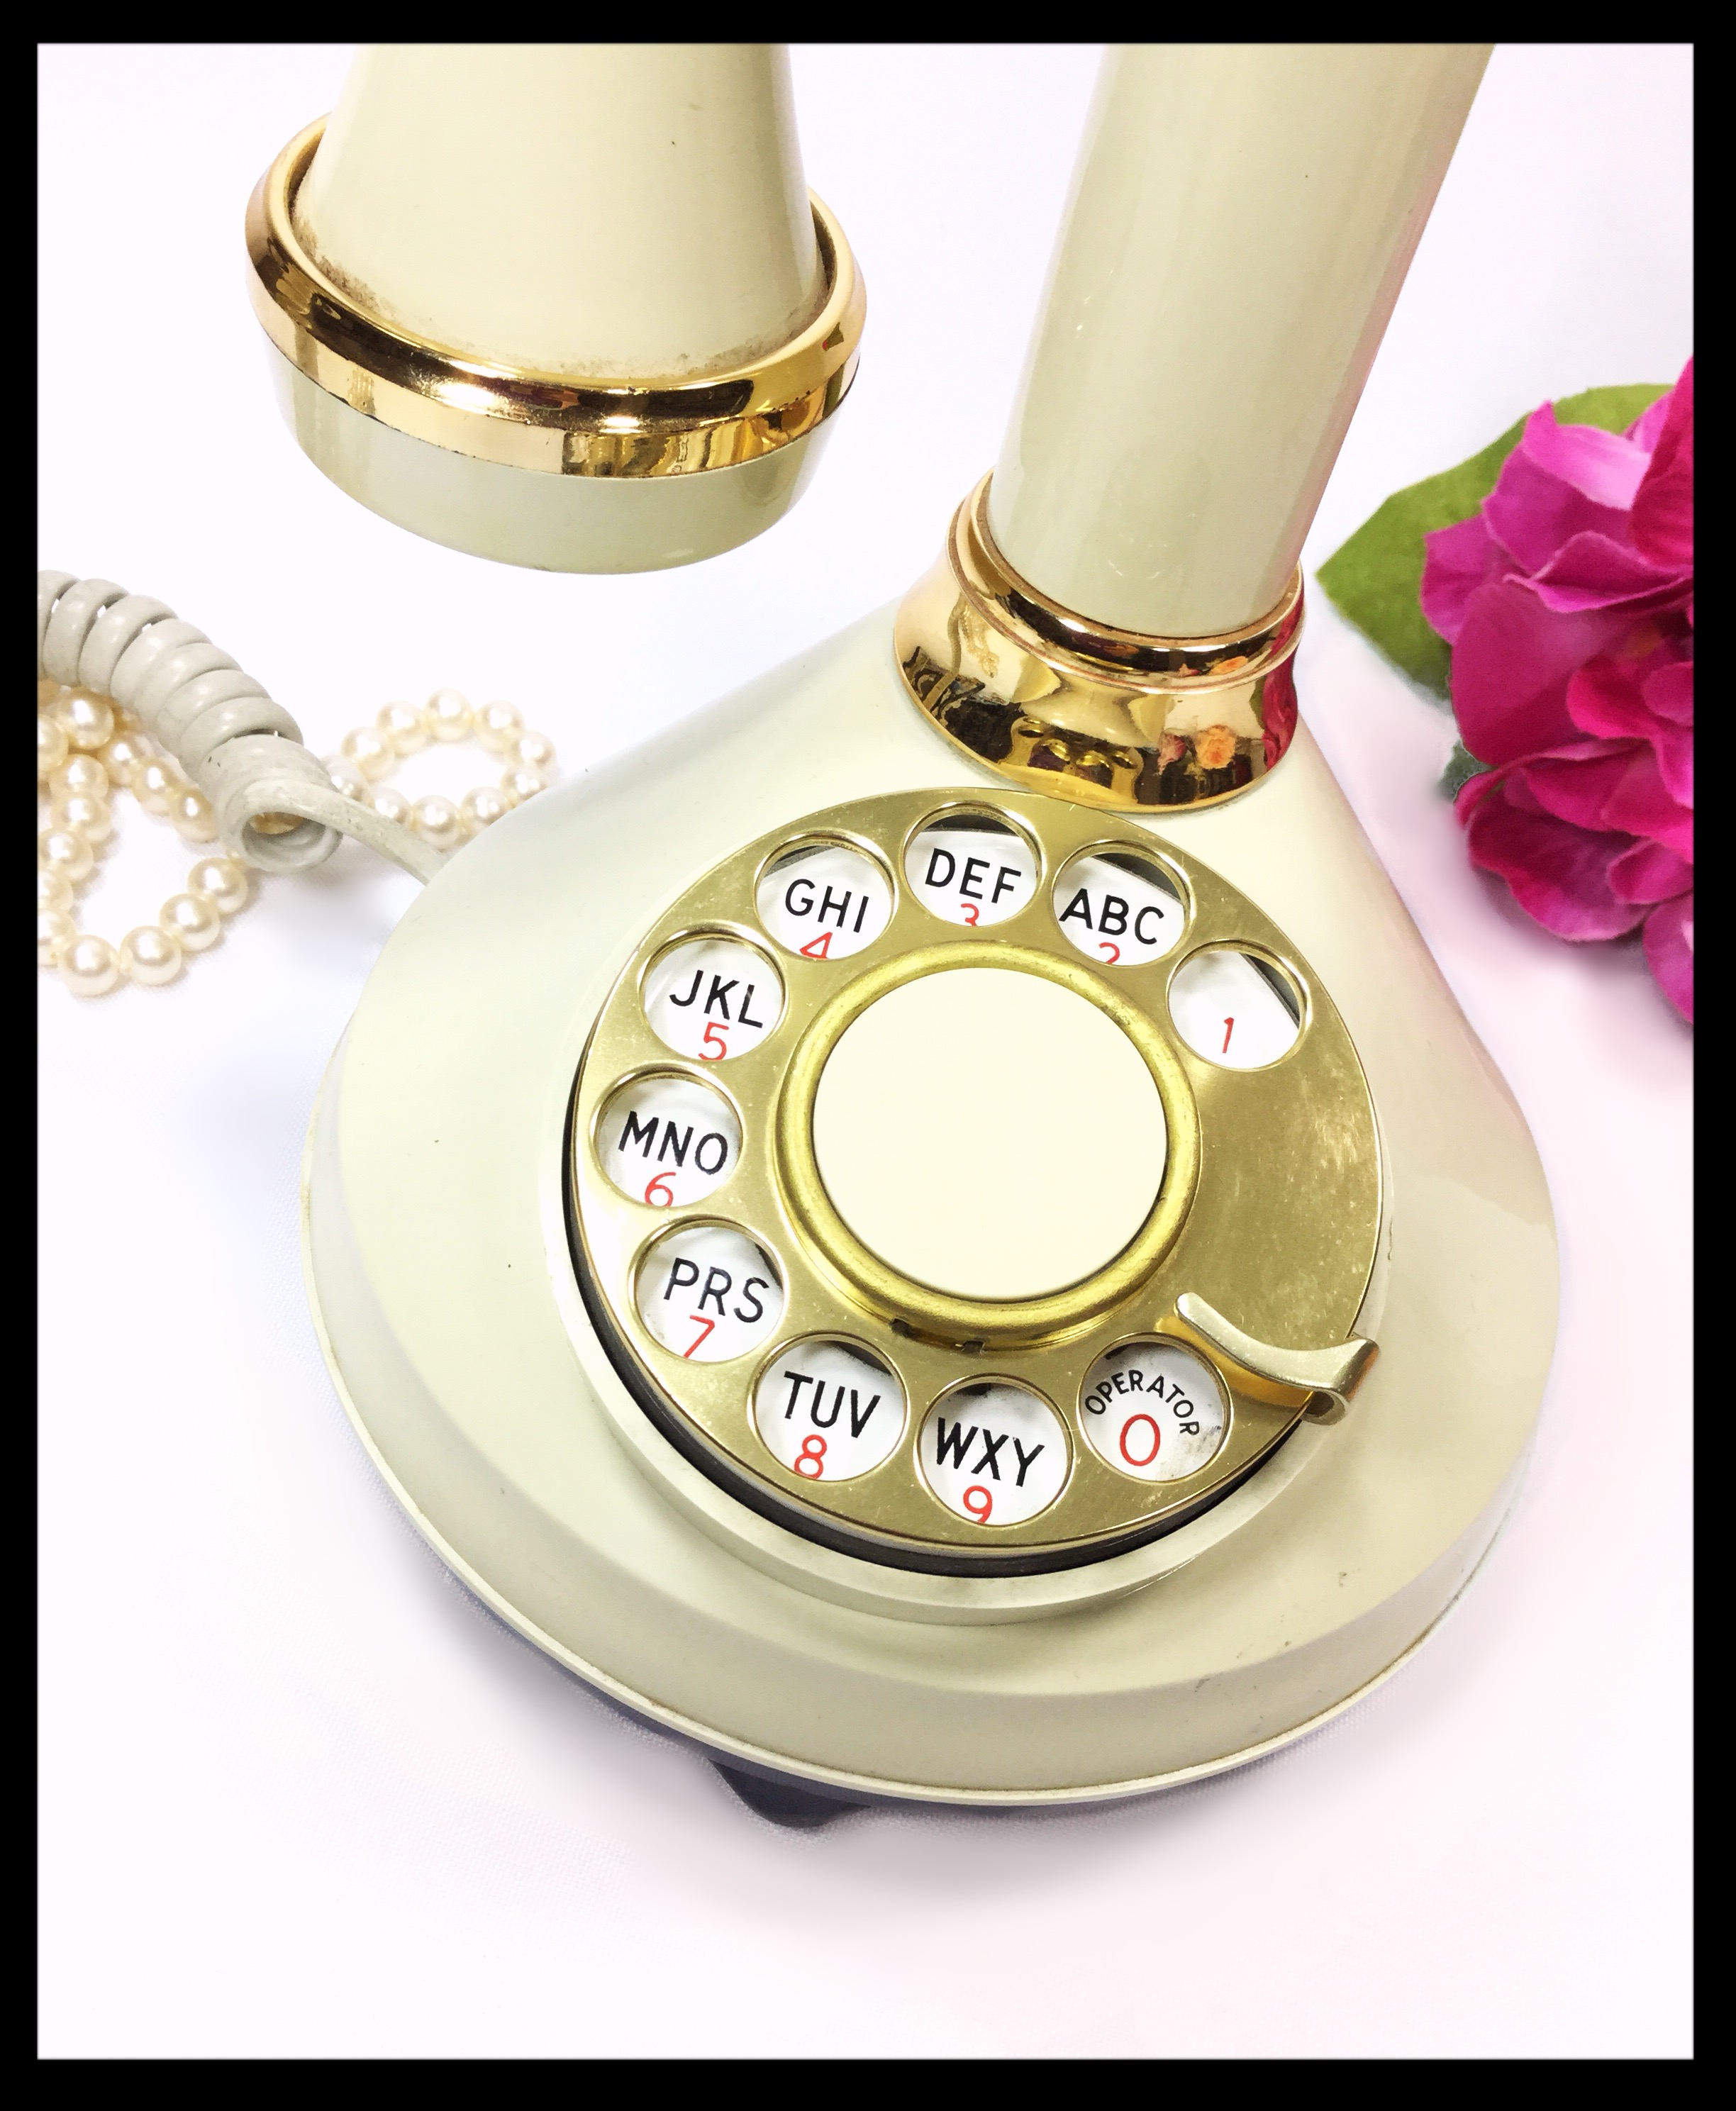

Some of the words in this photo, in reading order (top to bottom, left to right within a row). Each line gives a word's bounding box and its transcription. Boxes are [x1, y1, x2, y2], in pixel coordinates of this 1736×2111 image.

[925, 848, 1021, 903] DEF
[786, 879, 869, 932] GHI
[1059, 889, 1164, 945] ABC
[800, 932, 832, 959] 4
[669, 970, 762, 1027] JKL
[699, 1022, 728, 1061] 5
[1223, 1018, 1234, 1052] 1
[619, 1111, 728, 1174] MNO
[645, 1172, 675, 1207] 6
[664, 1257, 769, 1323] PRS
[684, 1315, 715, 1358] 7
[784, 1371, 880, 1438] TUV
[1085, 1369, 1200, 1438] OPERATOR
[794, 1435, 827, 1479] 8
[937, 1417, 1045, 1487] WXY
[1120, 1414, 1160, 1466] 0
[963, 1486, 992, 1524] 9
